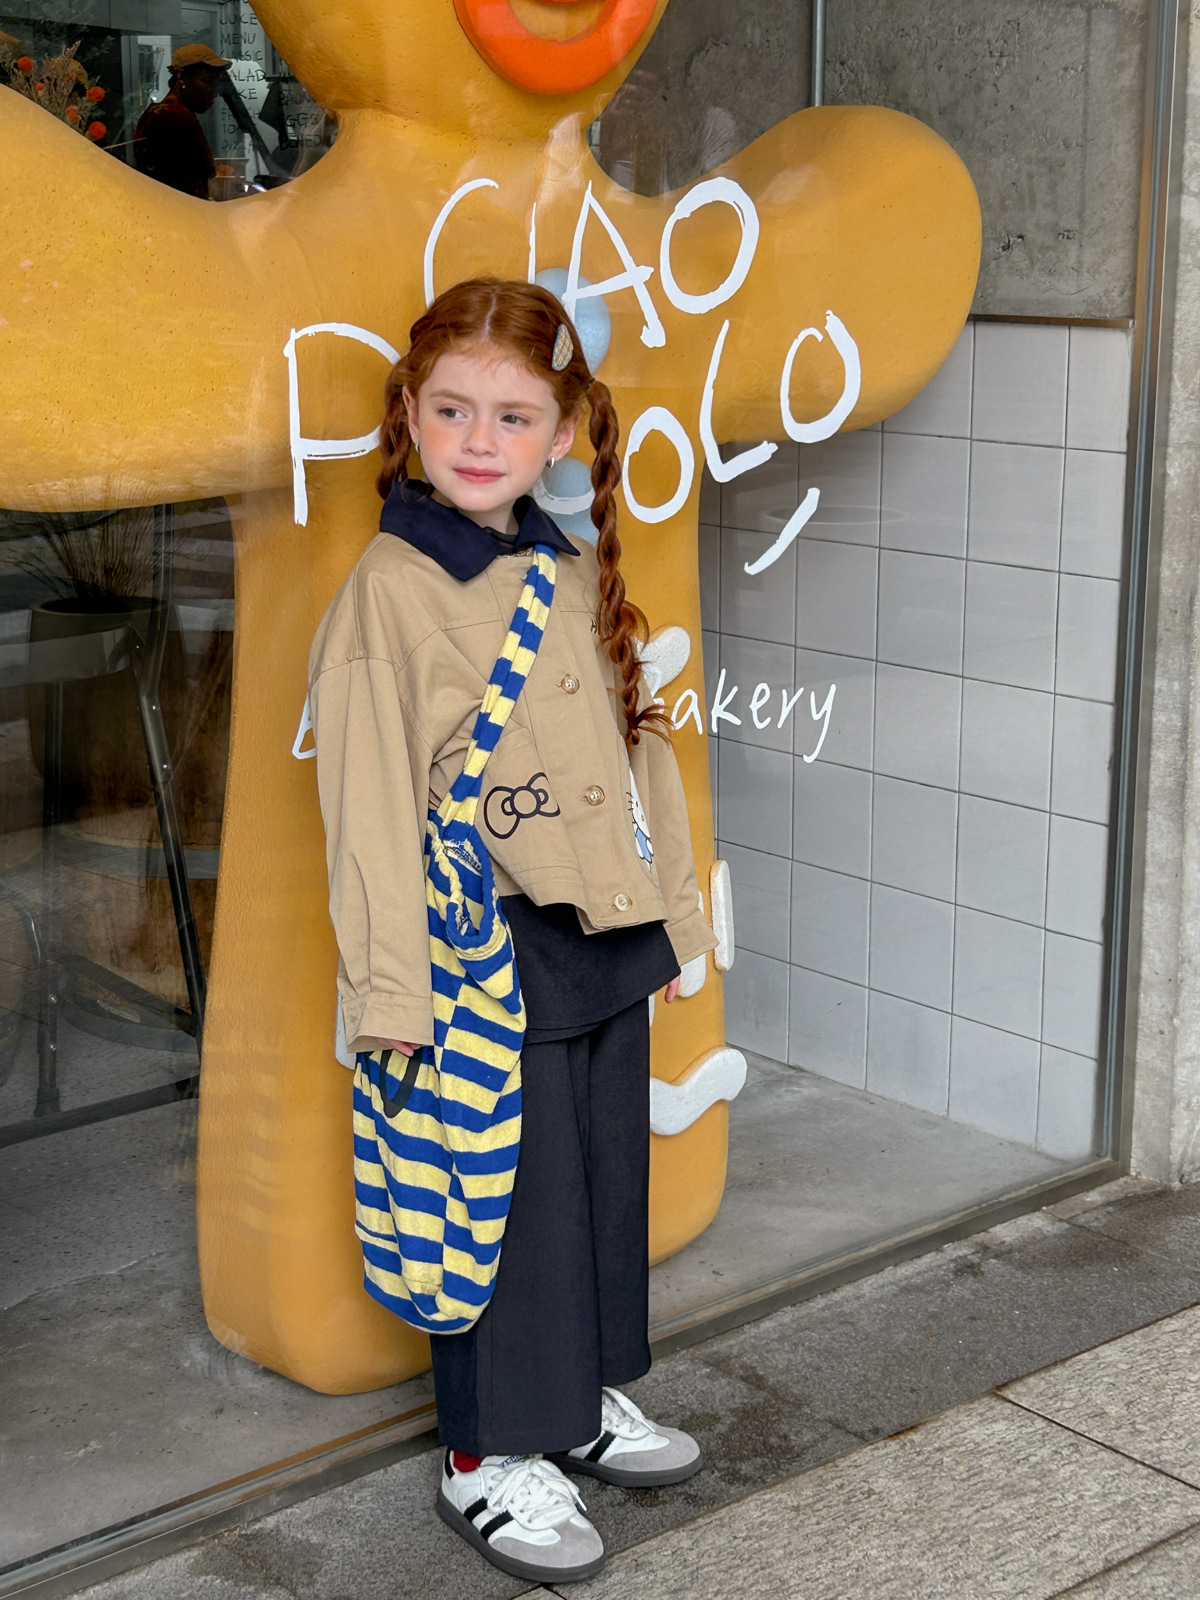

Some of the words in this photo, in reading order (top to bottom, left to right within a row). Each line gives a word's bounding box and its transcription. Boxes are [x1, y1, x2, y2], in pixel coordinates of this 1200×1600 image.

[220, 32, 256, 45] MENU
[231, 69, 266, 82] ALAD
[423, 176, 760, 348] CIAO
